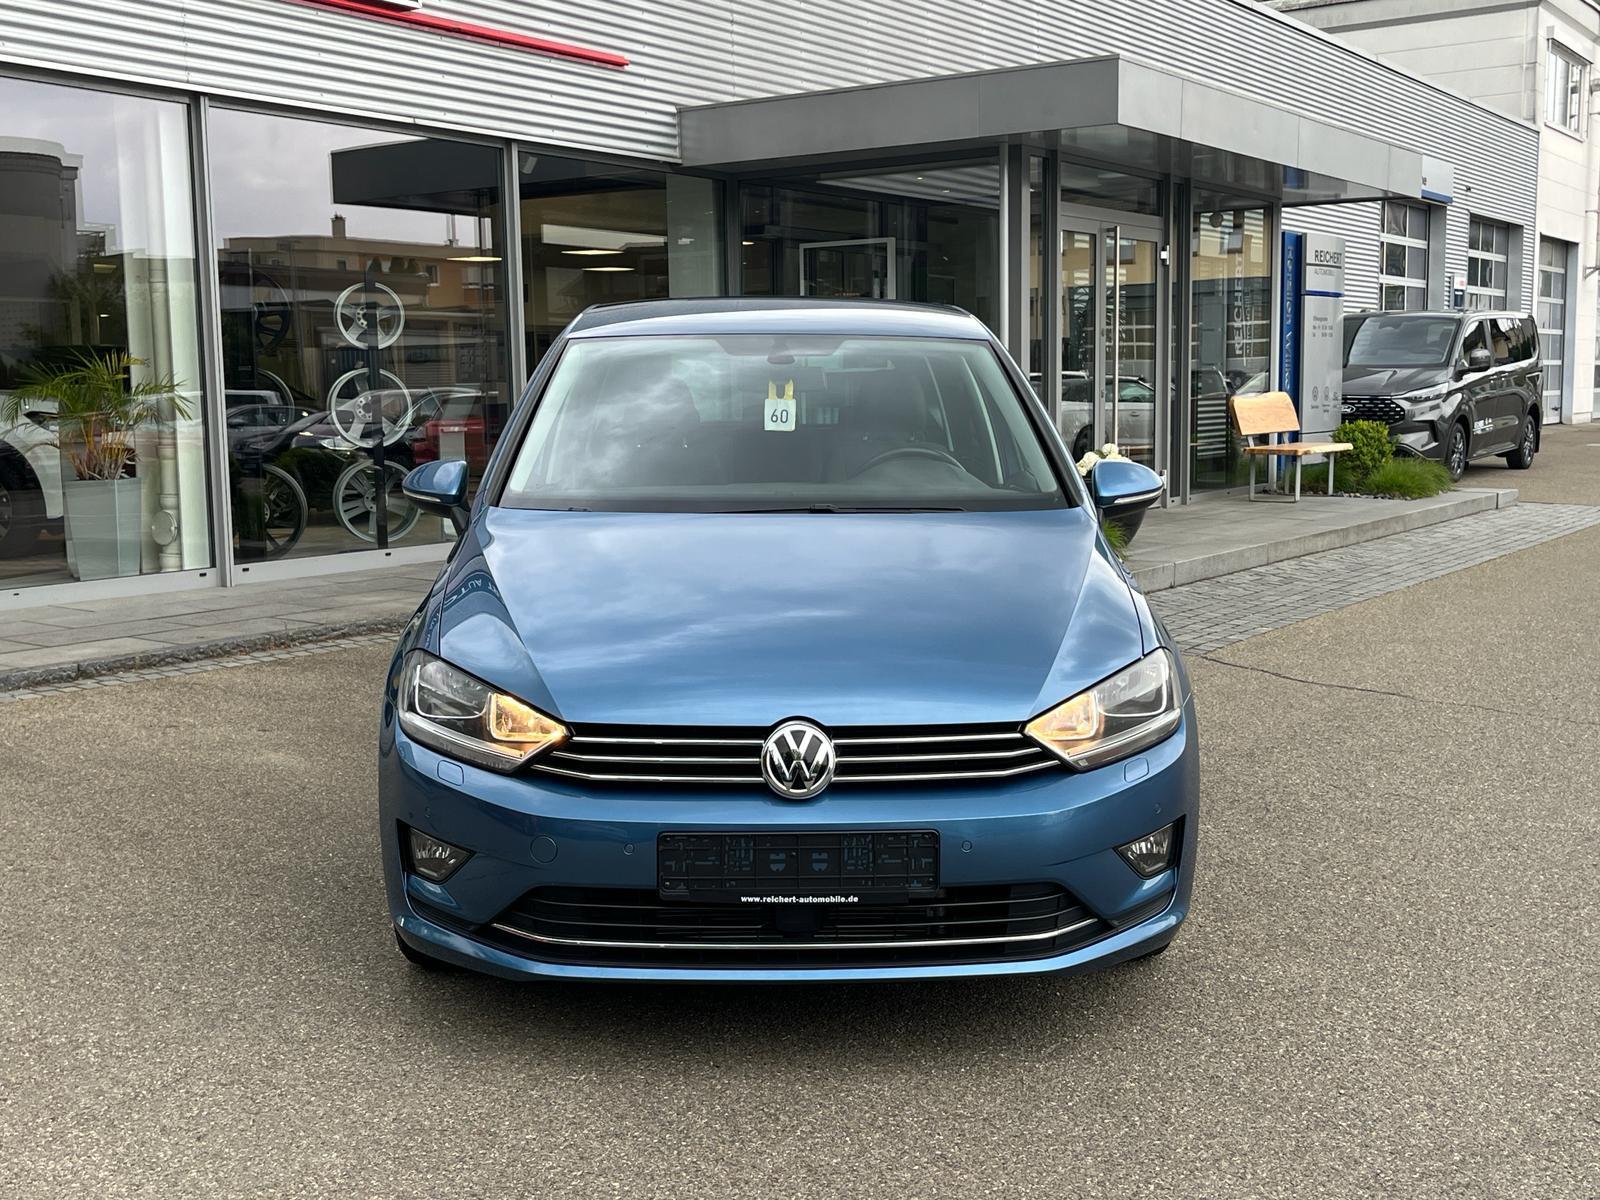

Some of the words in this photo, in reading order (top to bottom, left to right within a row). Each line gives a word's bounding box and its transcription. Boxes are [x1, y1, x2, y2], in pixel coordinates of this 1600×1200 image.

[1314, 249, 1342, 265] REICHERT
[1234, 253, 1243, 355] REICHERT
[770, 408, 789, 424] 60
[740, 895, 859, 903] www.reichert-automobile.de
